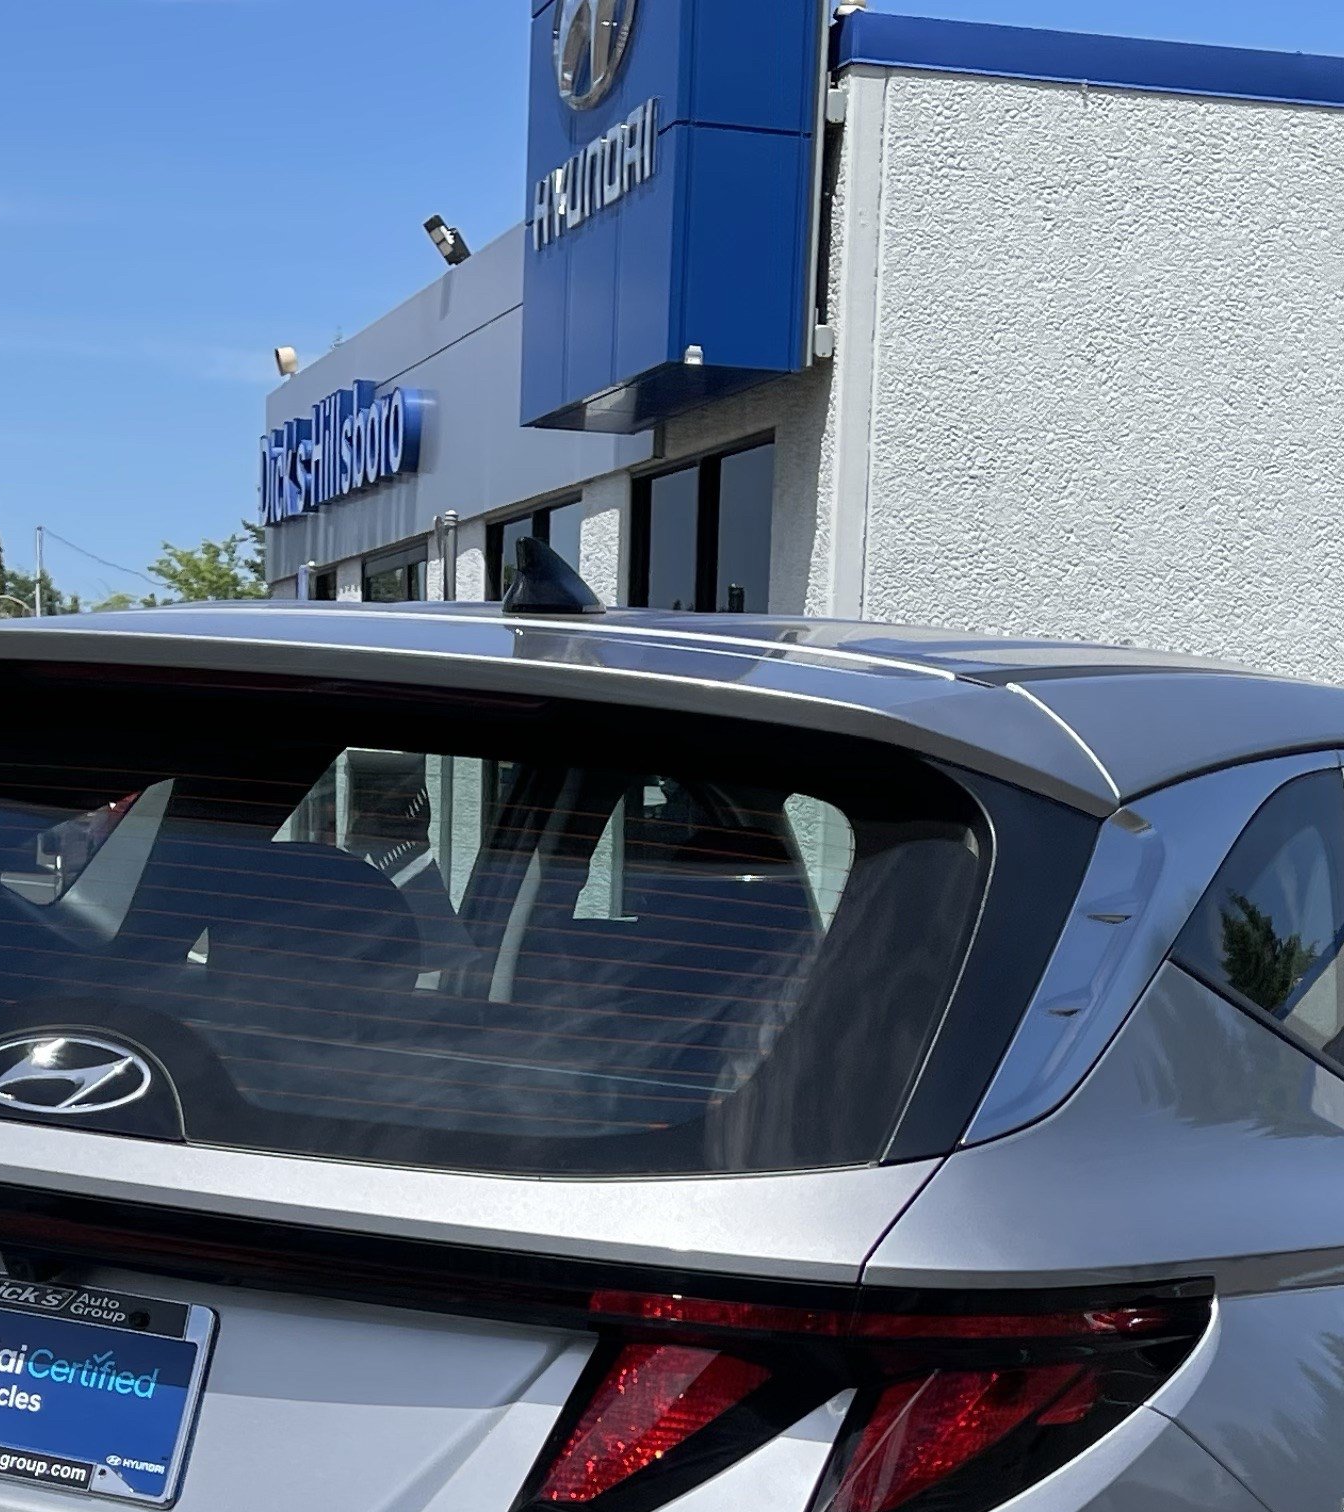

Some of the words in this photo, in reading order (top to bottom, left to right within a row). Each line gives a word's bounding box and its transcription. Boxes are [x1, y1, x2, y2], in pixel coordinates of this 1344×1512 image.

[532, 97, 658, 251] HYUNDAI
[311, 380, 408, 506] Hillsboro
[75, 1292, 120, 1310] Auto
[69, 1302, 126, 1324] Group
[122, 1458, 166, 1475] HYUNDAI
